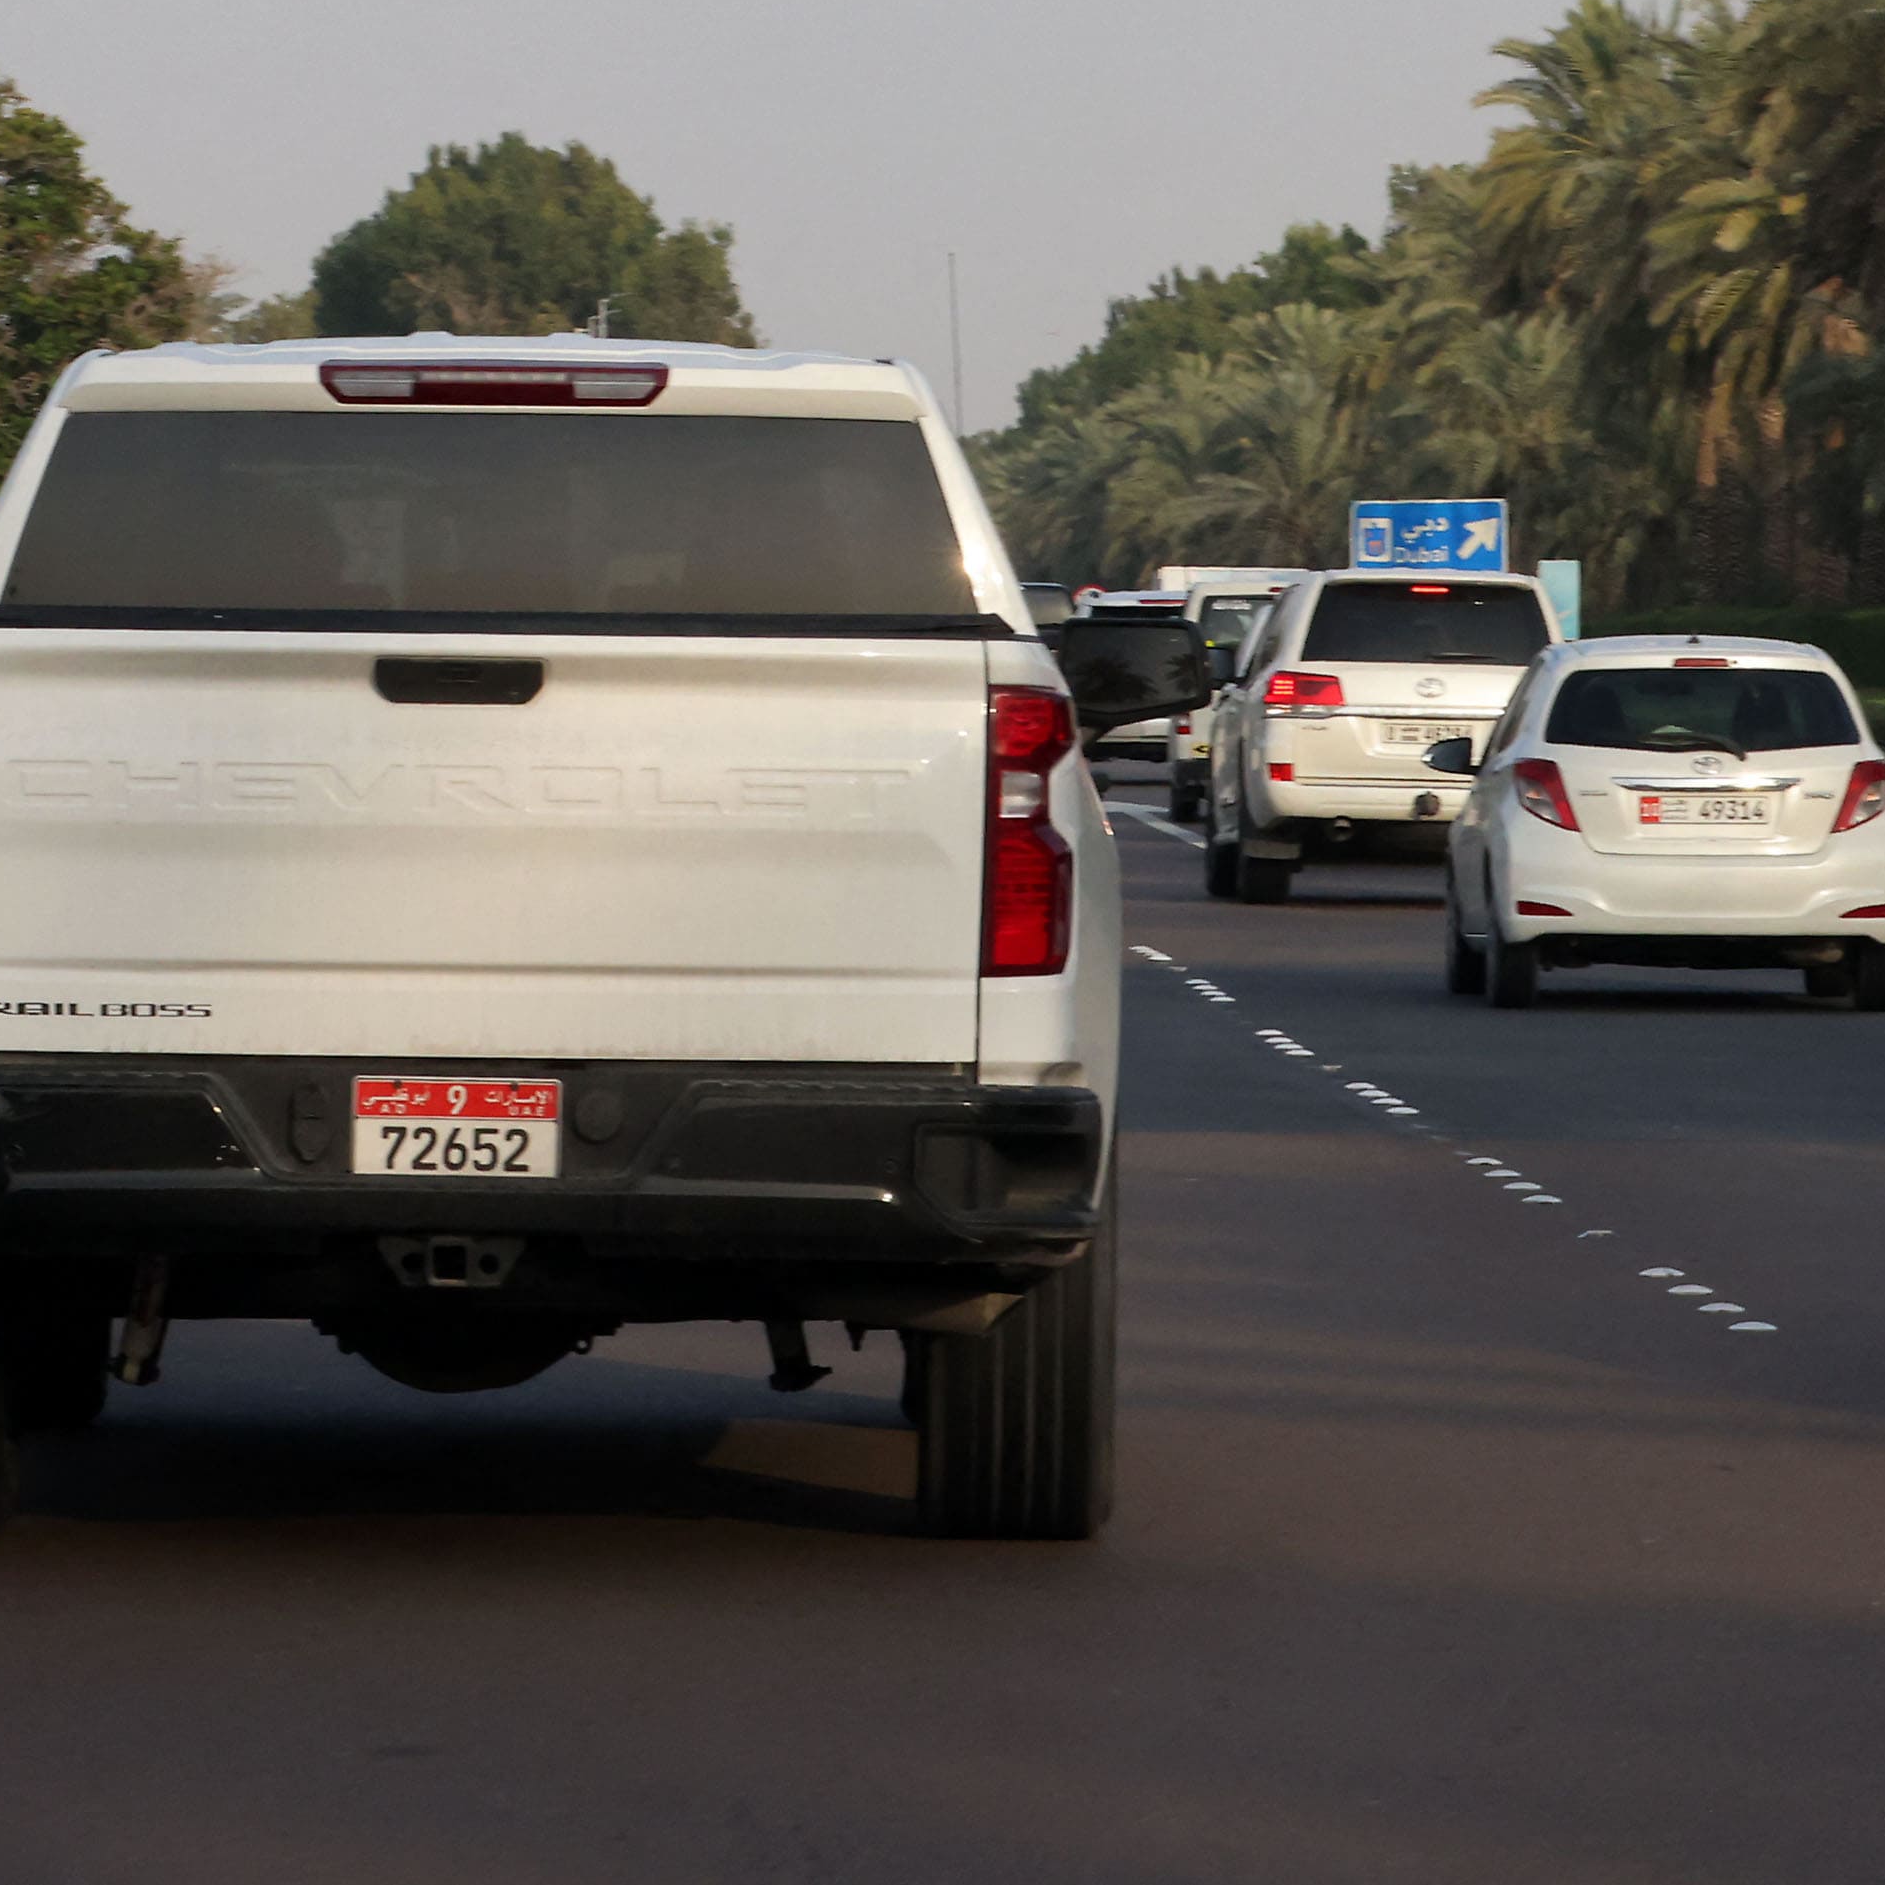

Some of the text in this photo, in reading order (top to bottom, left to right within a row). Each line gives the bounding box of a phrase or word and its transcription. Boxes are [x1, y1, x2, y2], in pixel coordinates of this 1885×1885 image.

[1394, 545, 1450, 563] Dubai
[3, 758, 911, 818] CHEVROLET
[100, 1002, 213, 1018] BOSS
[446, 1084, 467, 1116] 9
[381, 1125, 530, 1173] 72652
